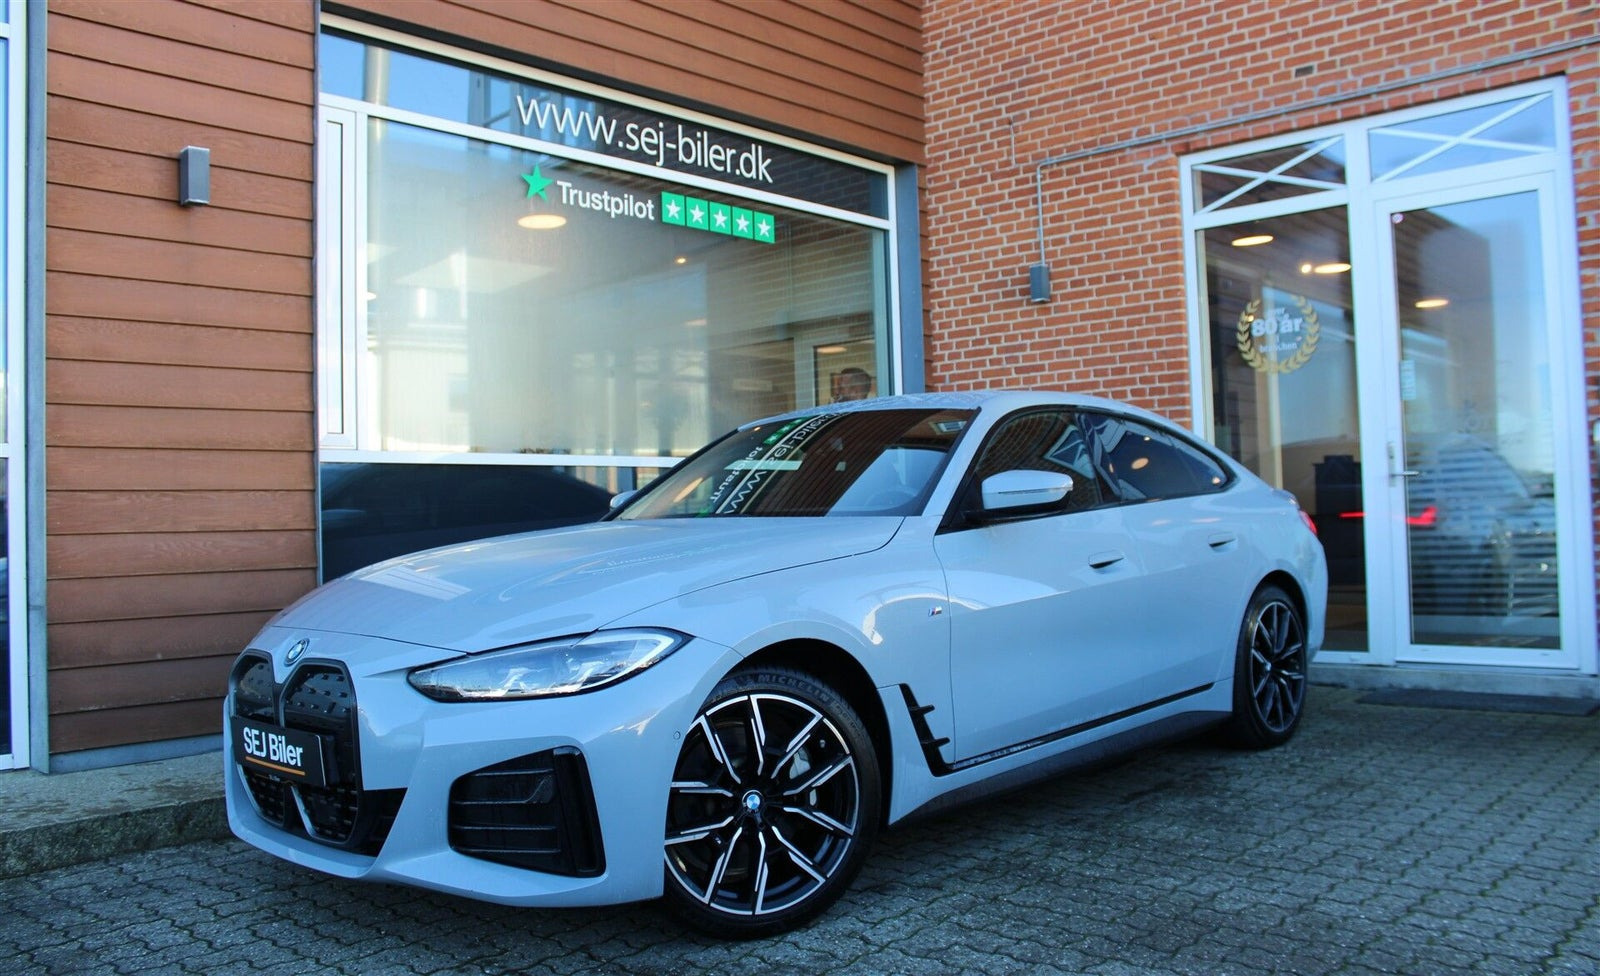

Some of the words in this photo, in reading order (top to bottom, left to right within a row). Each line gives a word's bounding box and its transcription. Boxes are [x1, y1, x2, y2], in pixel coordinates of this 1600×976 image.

[516, 95, 774, 184] www.sej-biler.dk
[557, 180, 655, 221] Trustpilot
[1251, 318, 1278, 337] 80
[1279, 313, 1303, 334] år
[757, 673, 831, 703] MICHELIN
[243, 726, 267, 758] SEJ
[268, 732, 304, 767] Biler
